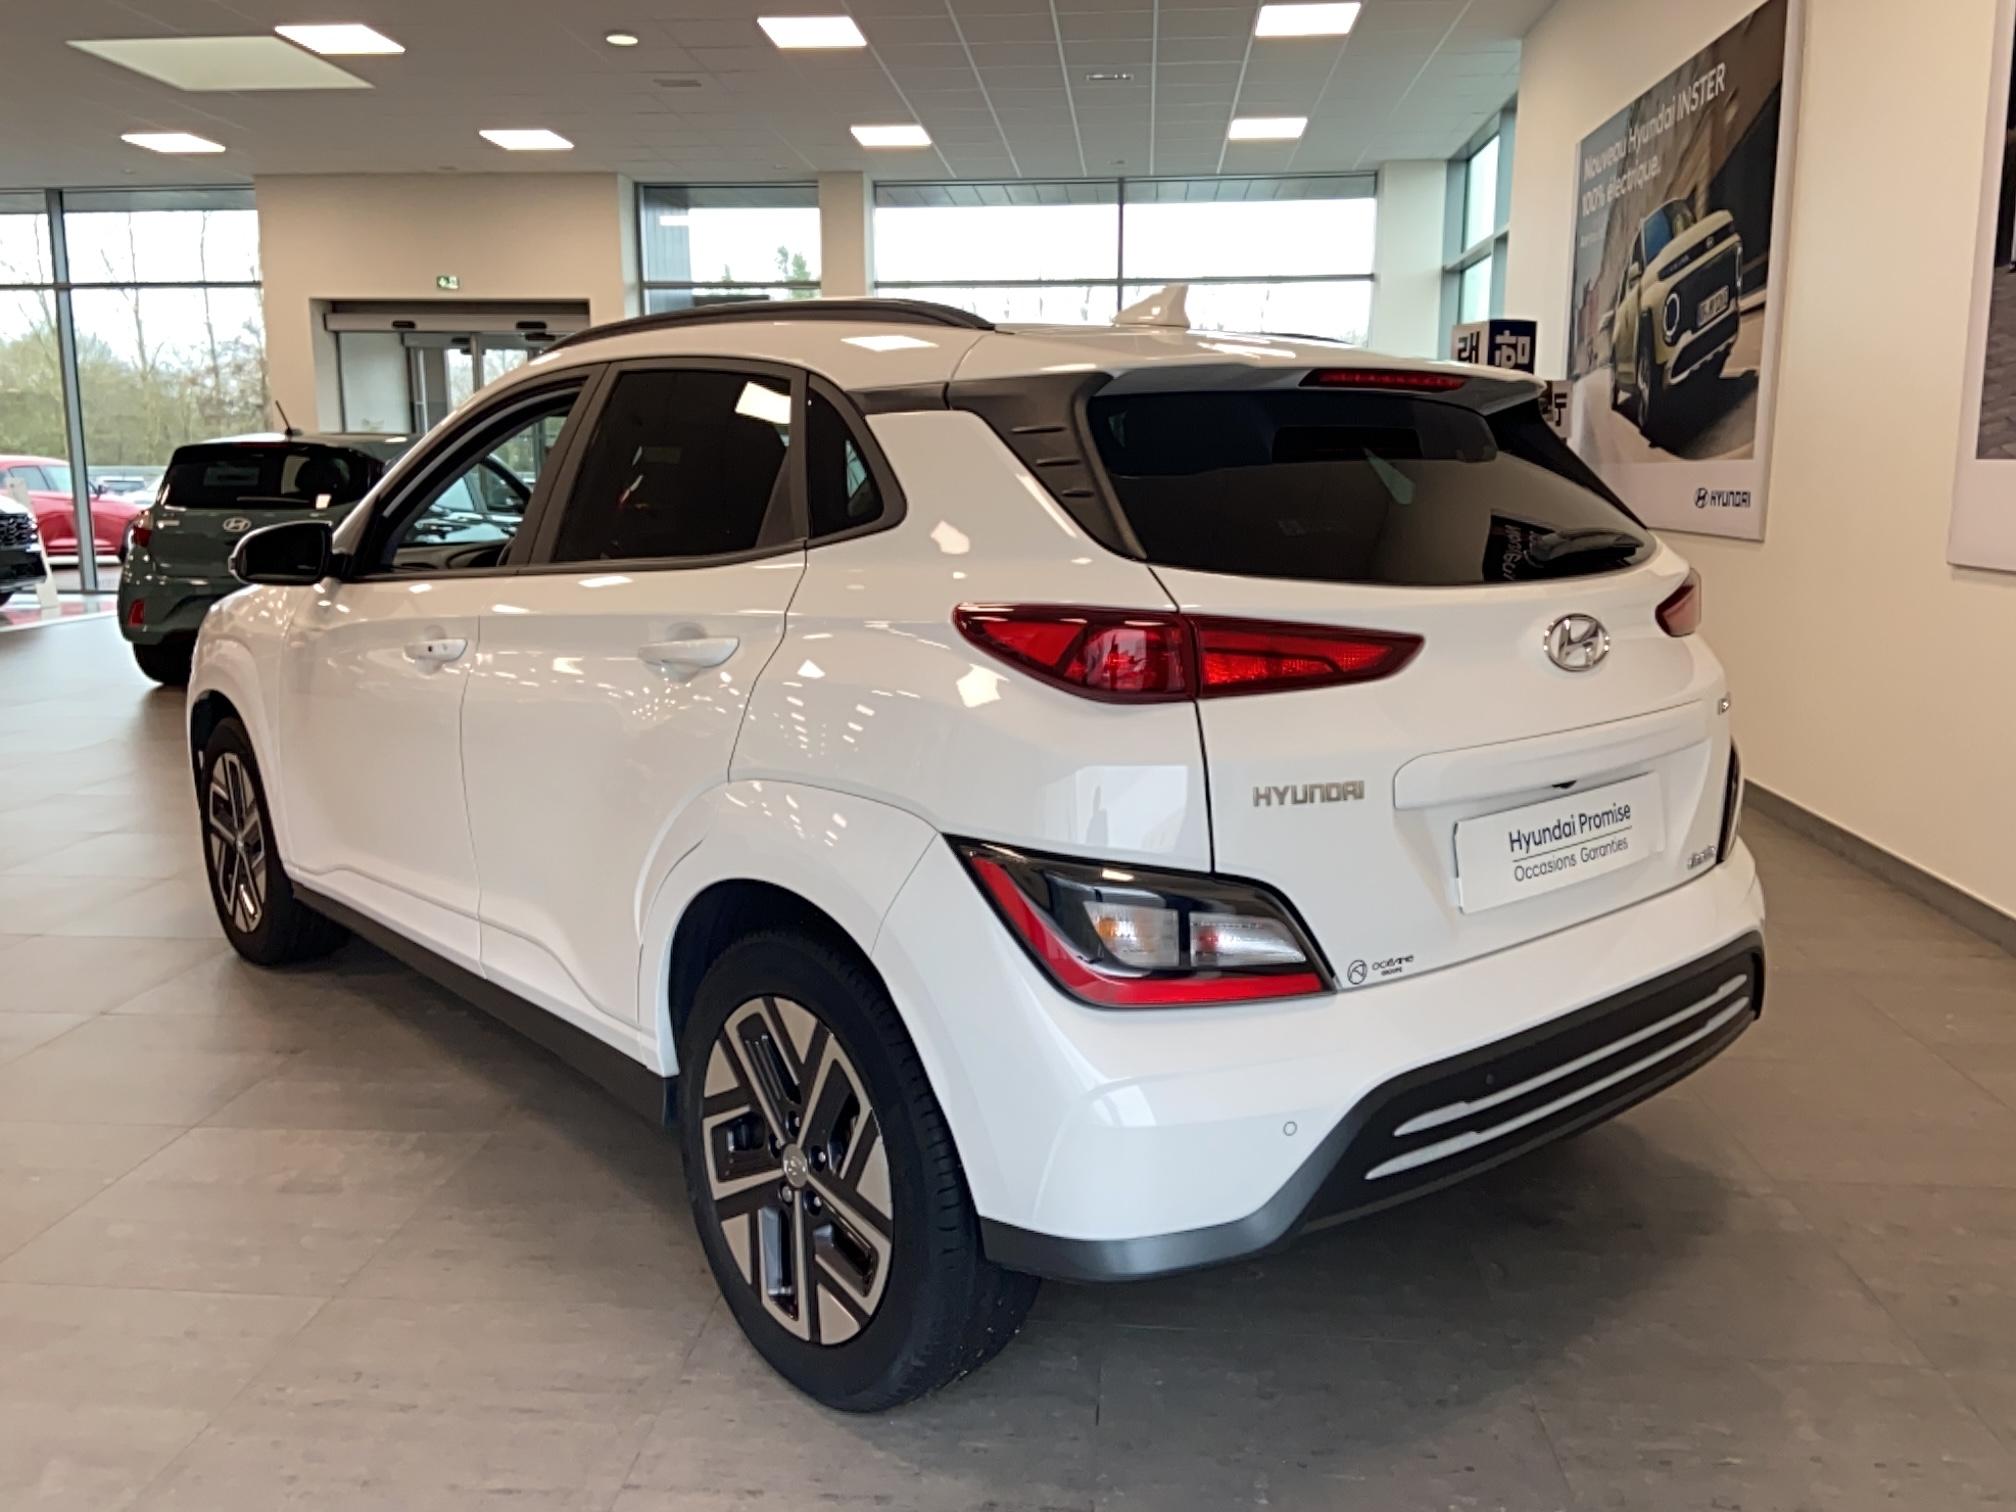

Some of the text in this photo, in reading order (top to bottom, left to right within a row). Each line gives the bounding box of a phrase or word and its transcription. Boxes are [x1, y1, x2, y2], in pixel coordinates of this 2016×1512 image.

[1583, 62, 1726, 181] Nouveau Hyundai INSTER
[1582, 184, 1605, 217] 100%
[1710, 490, 1751, 507] HYUNDAI
[1252, 780, 1365, 808] HYUNDAI
[1508, 802, 1631, 854] Hyundai Promise
[1514, 837, 1629, 882] Occasions Garanties
